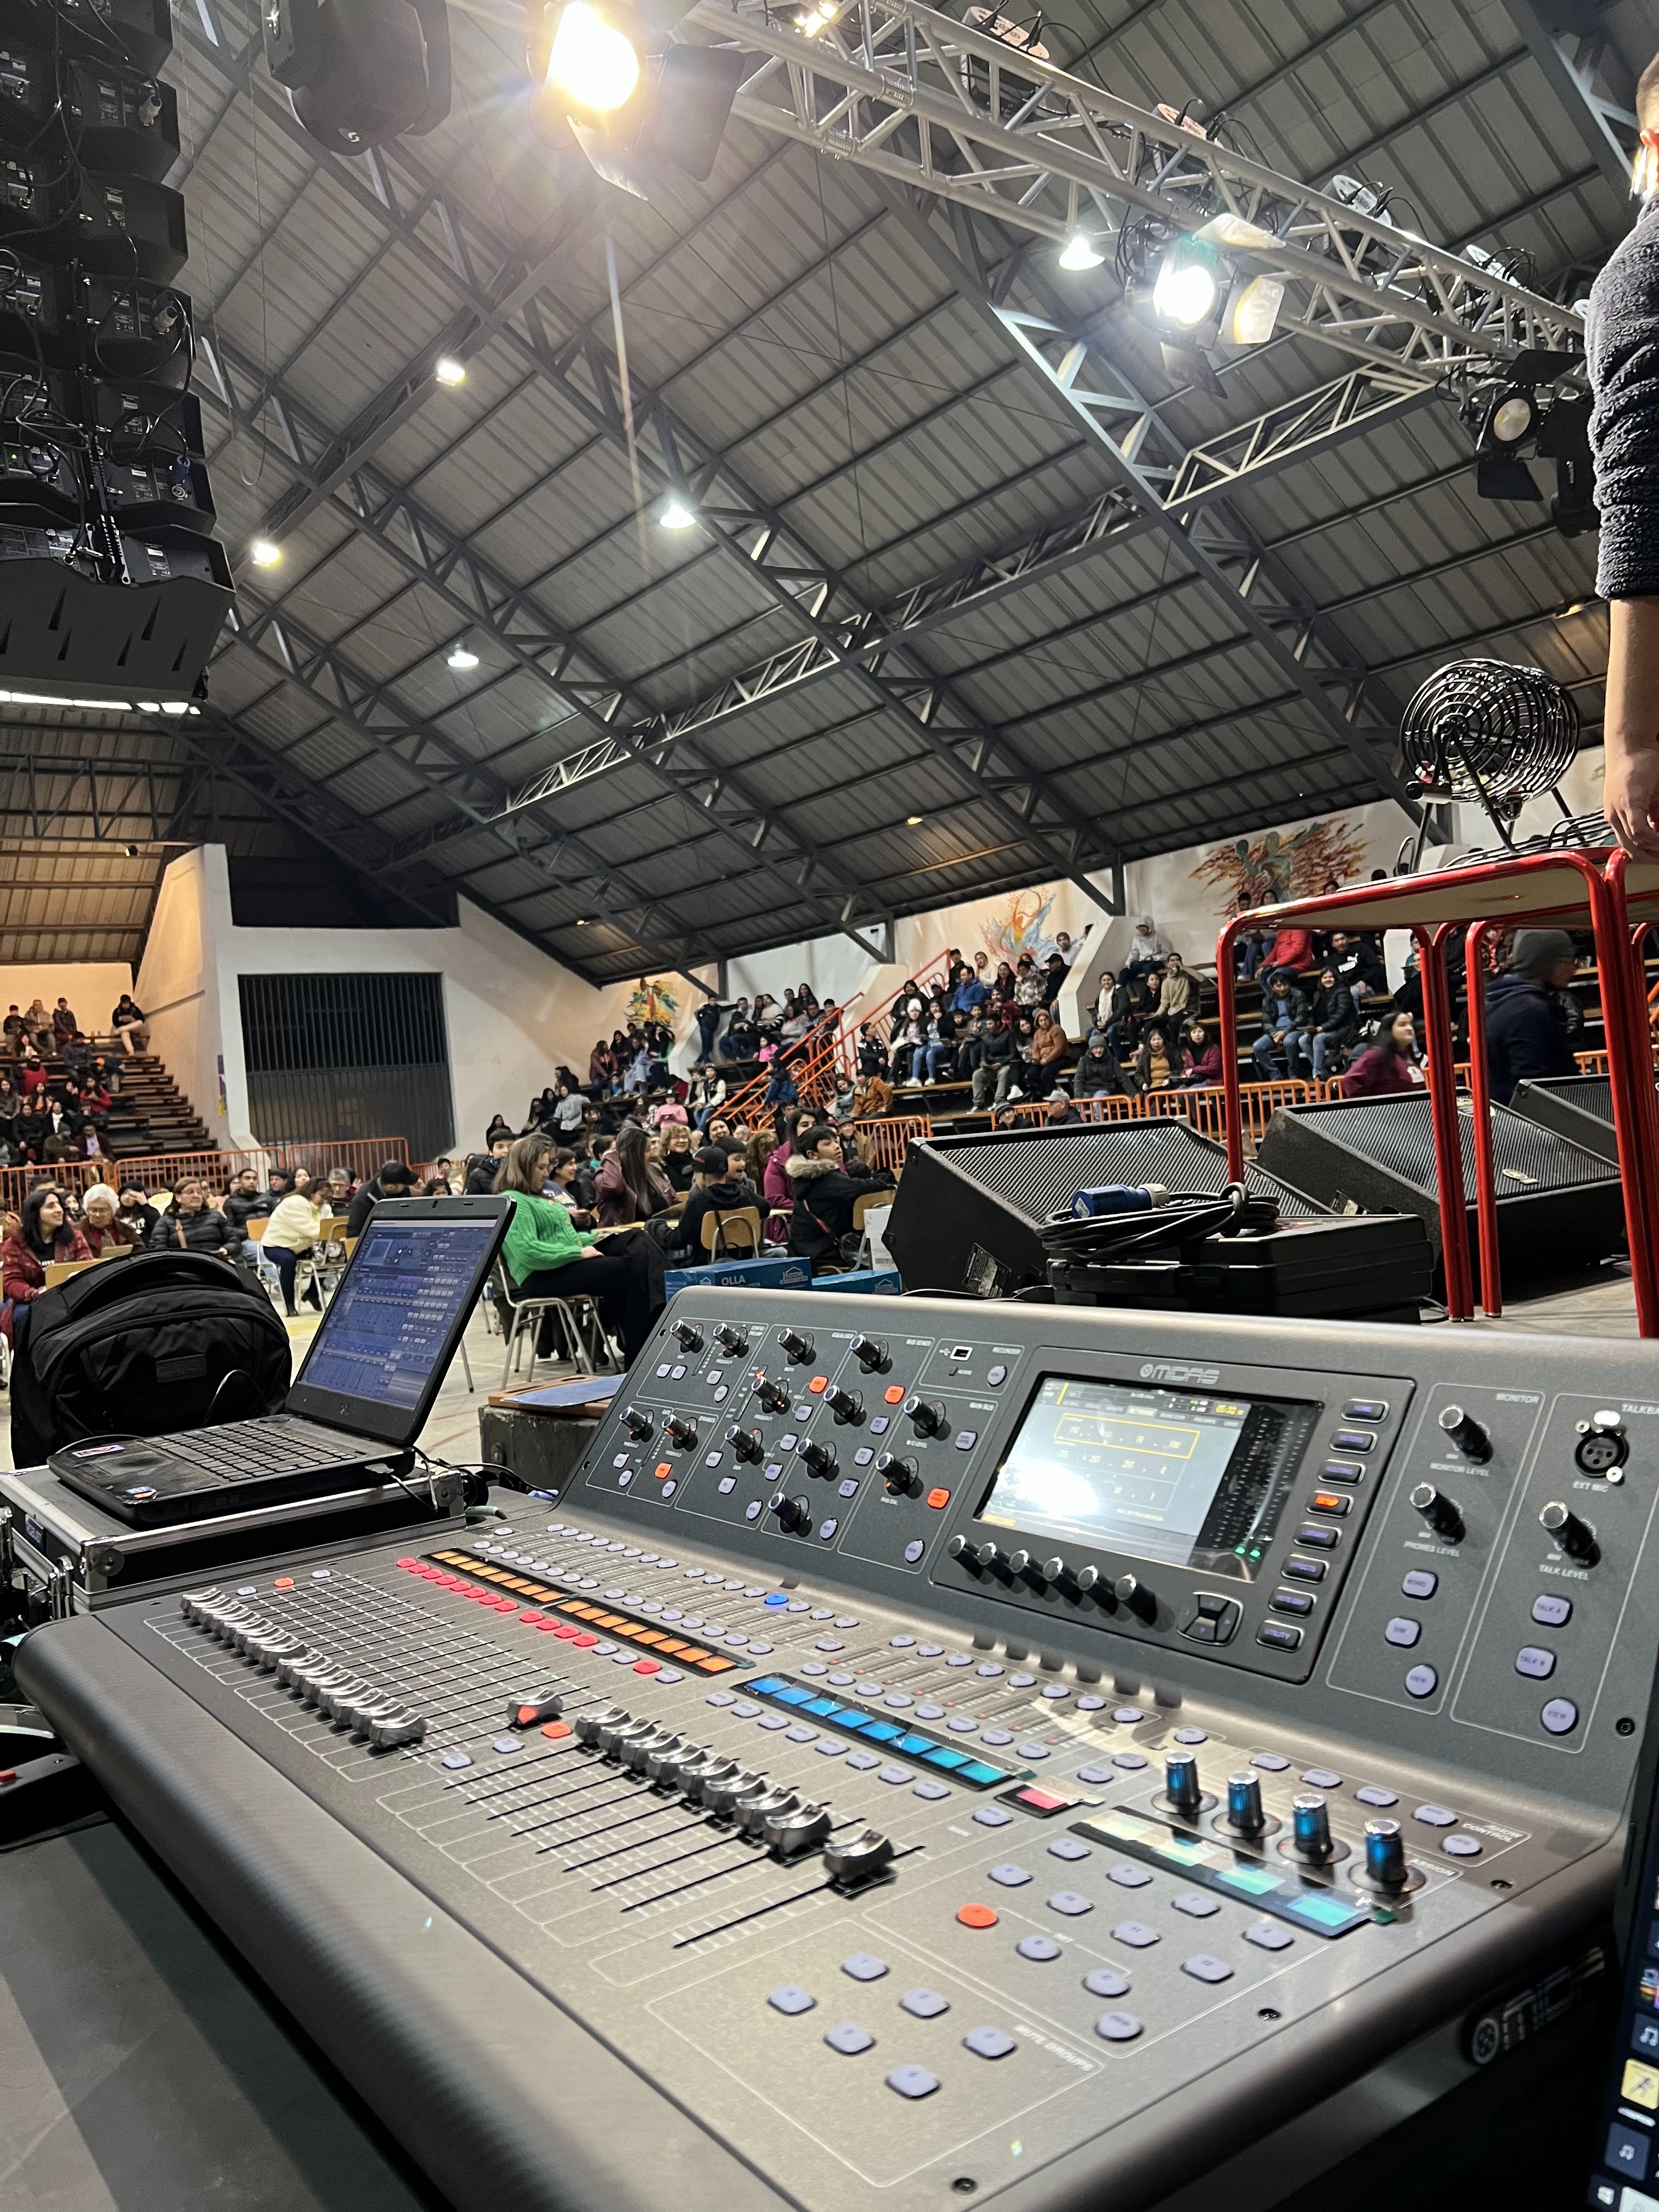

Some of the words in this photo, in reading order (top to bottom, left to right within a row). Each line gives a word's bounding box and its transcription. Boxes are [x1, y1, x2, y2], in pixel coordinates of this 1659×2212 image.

[721, 1274, 746, 1286] OLLA
[782, 1270, 803, 1279] Home
[1150, 1365, 1221, 1385] MIDAS
[1496, 1393, 1540, 1404] MONITOR
[1430, 1463, 1465, 1474] MONITOR
[1465, 1467, 1489, 1477] LEVEL
[1572, 1481, 1592, 1490] EXT
[1592, 1483, 1609, 1493] MIC
[1403, 1541, 1436, 1553] PHONES
[1436, 1547, 1460, 1558] LEVEL
[1539, 1565, 1561, 1575] TALK
[1561, 1568, 1589, 1581] LEVEL
[1407, 1578, 1427, 1588] MONO
[1537, 1604, 1554, 1612] TALK
[1521, 1655, 1538, 1663] TALK
[1410, 1674, 1427, 1684] VIEW
[1548, 1709, 1567, 1720] VIEW
[1462, 1823, 1514, 1843] CONTROL
[1408, 1859, 1456, 1876] ASSIGN
[1014, 2025, 1048, 2045] MUTE
[1045, 2042, 1093, 2072] GROUPS
